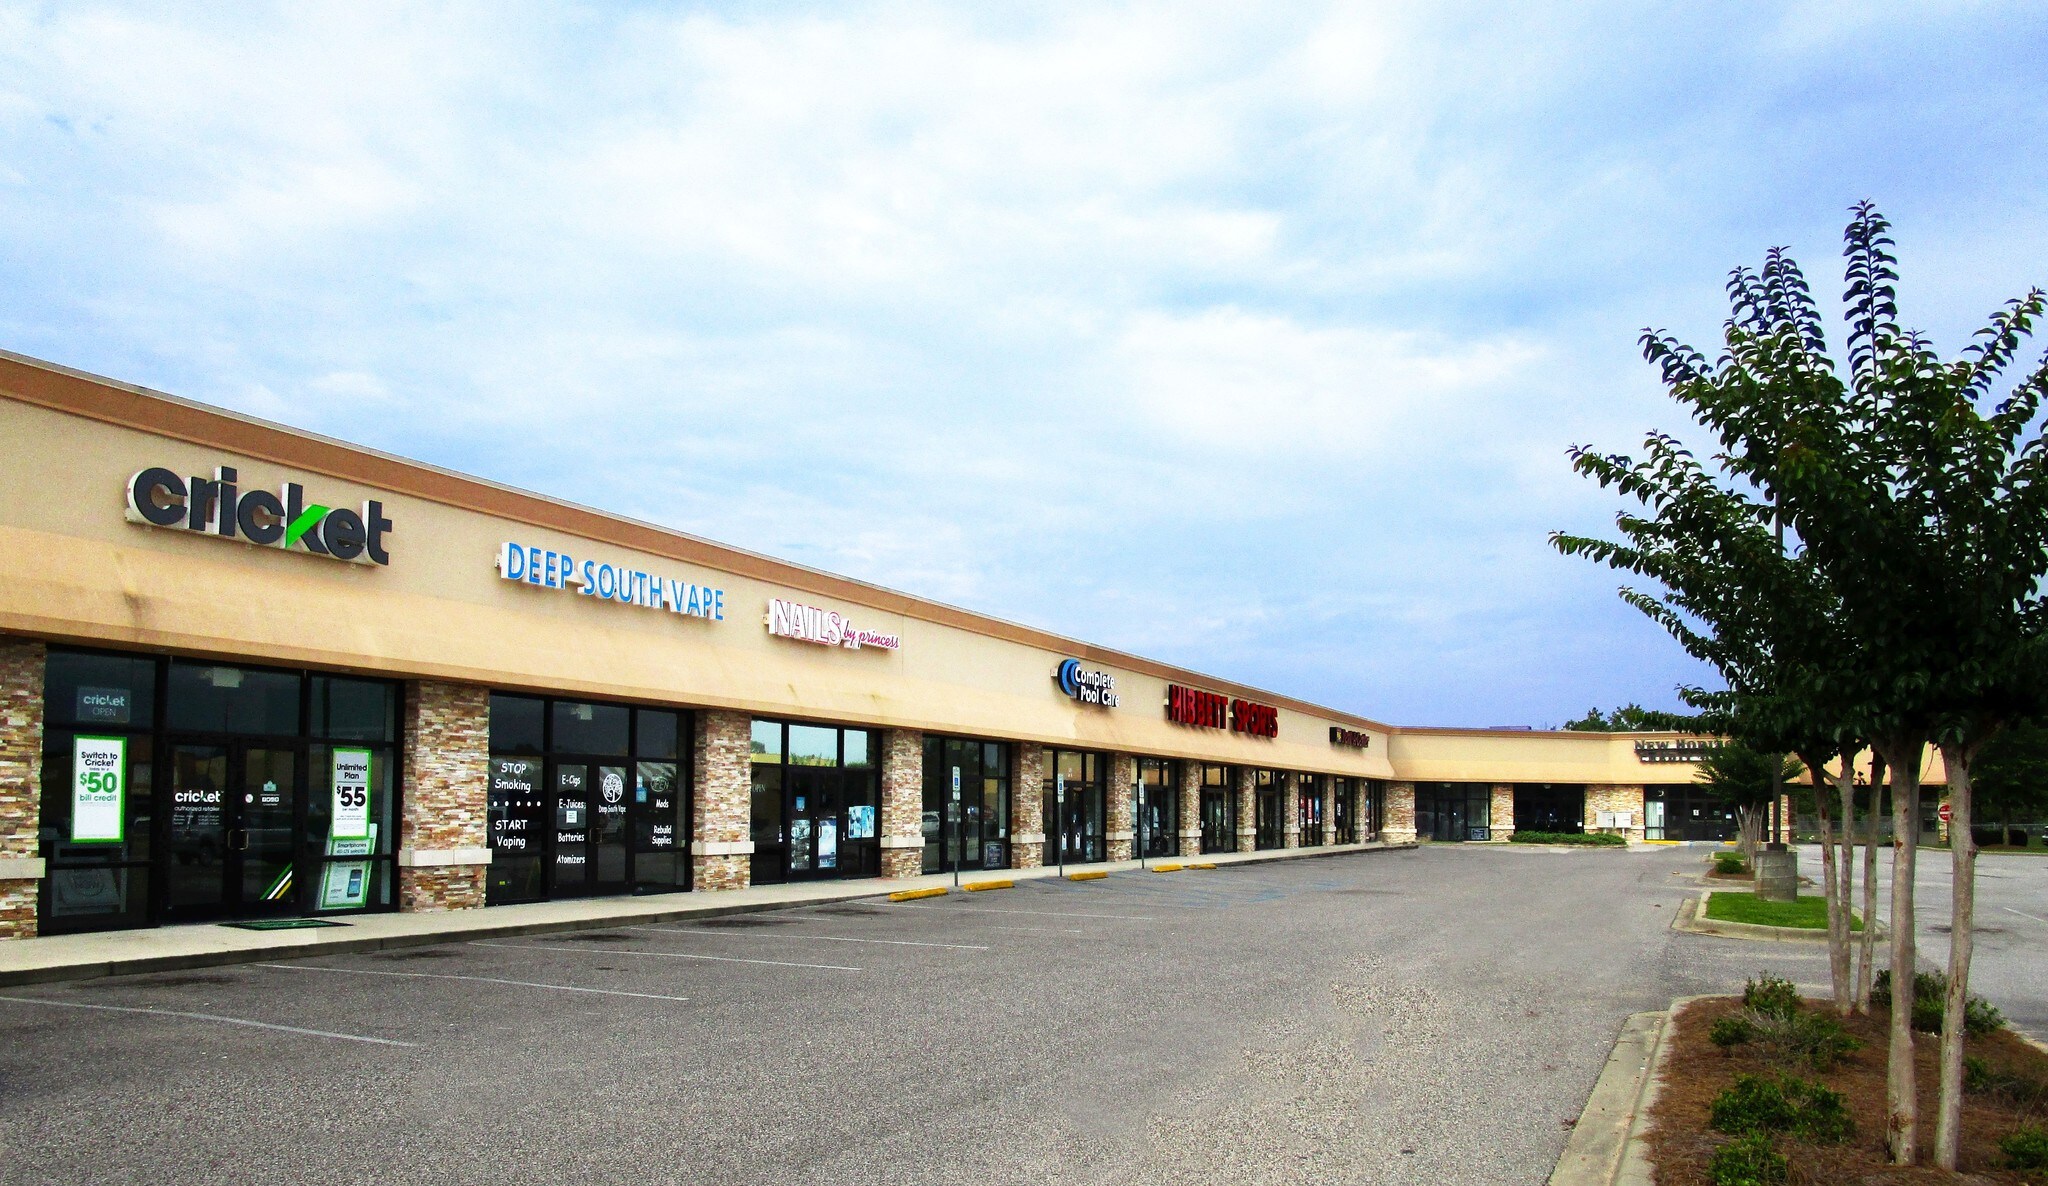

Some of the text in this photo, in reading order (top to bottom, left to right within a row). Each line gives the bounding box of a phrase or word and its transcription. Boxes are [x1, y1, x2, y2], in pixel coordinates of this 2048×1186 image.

[132, 466, 393, 565] cricket
[505, 542, 724, 621] DEEP SOUTH VAPE
[774, 599, 899, 649] NAILS by princess
[1074, 666, 1115, 690] Complete
[83, 694, 125, 706] cricket
[1081, 685, 1120, 708] Pool Care
[1170, 684, 1278, 738] HIBBETT SPORTS
[81, 751, 118, 760] Switch to
[84, 759, 114, 767] Cricket
[336, 763, 368, 772] Unlimited
[501, 763, 527, 774] STOP
[344, 771, 360, 780] Plan
[561, 774, 581, 787] E-Cigs
[79, 771, 117, 793] $50
[494, 778, 531, 794] Smoking
[94, 794, 117, 802] credit
[174, 790, 221, 803] cricket
[336, 785, 366, 807] $55
[558, 798, 584, 809] E-Juices
[655, 799, 669, 808] Mods
[495, 819, 528, 830] START
[653, 825, 672, 834] Rebuild
[496, 835, 526, 849] Vaping
[558, 832, 585, 843] Batteries
[651, 836, 672, 847] Supplies
[556, 854, 586, 864] Atomizers
